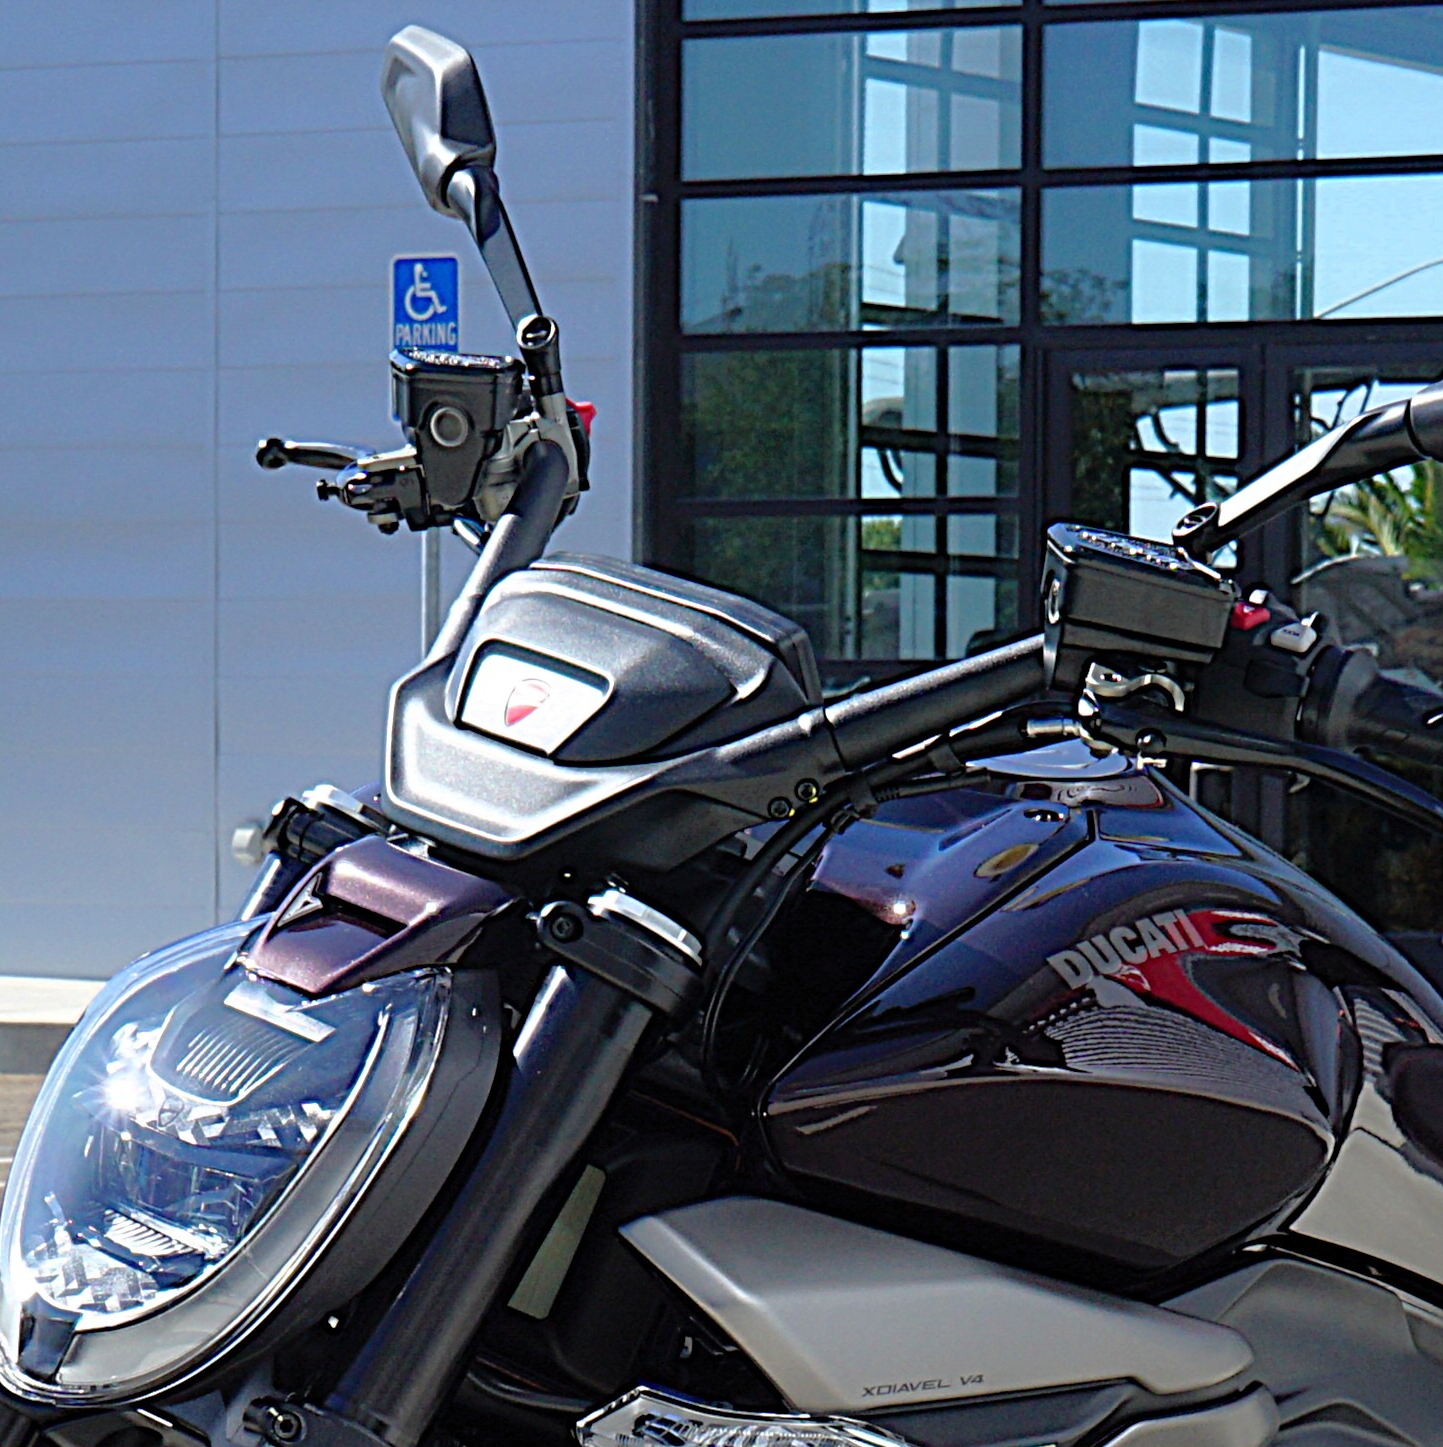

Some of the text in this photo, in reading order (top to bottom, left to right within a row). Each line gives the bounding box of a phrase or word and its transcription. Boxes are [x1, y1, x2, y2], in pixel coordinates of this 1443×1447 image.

[396, 322, 457, 346] PARKING
[1046, 908, 1206, 990] DUCATI
[861, 1373, 985, 1398] XDIAVEL V4
